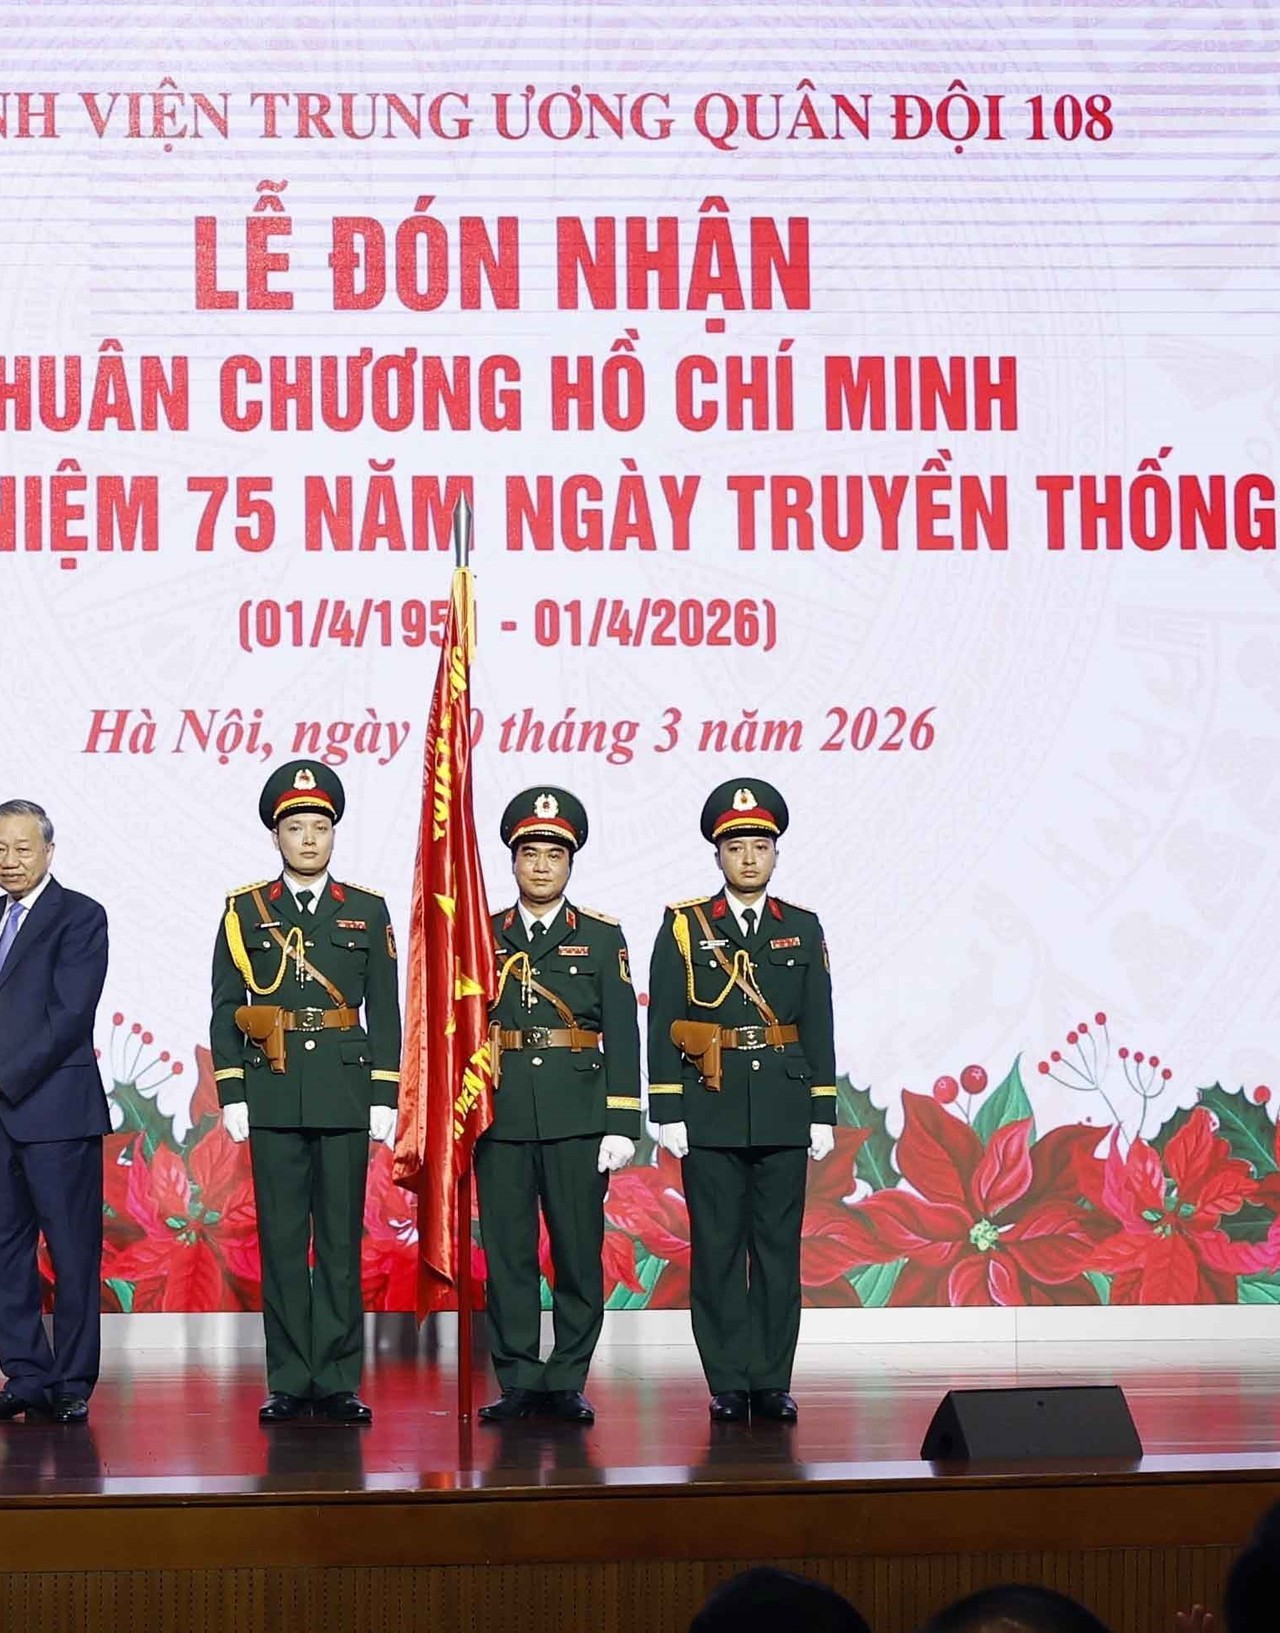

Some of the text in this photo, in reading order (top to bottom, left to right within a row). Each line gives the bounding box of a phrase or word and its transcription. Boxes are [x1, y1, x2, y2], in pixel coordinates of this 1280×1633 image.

[80, 77, 231, 153] VIỆN
[251, 91, 472, 140] TRUNG
[491, 84, 675, 142] ƯƠNG
[694, 78, 873, 152] QUÂN
[890, 78, 1005, 155] ĐỘI
[1024, 94, 1115, 142] 108
[195, 180, 811, 333] LỄ ĐÓN NHẬN
[219, 346, 522, 433] CHƯƠNG
[550, 327, 646, 433] HỒ
[675, 338, 795, 433] CHÍ
[824, 355, 1019, 432] MINH
[186, 476, 276, 553] 75
[304, 458, 475, 552] NĂM
[505, 457, 701, 553] NGÀY
[727, 448, 1009, 553] TRUYỀN
[1035, 445, 1277, 552] THỐNG
[239, 597, 777, 653] (01/4/195 - 01/4/2026)
[81, 708, 157, 755] Hà
[171, 708, 273, 765] Nội,
[292, 709, 411, 765] ngày
[499, 708, 639, 763] tháng
[655, 707, 682, 752] 3
[698, 709, 804, 754] năm
[819, 706, 936, 753] 2026
